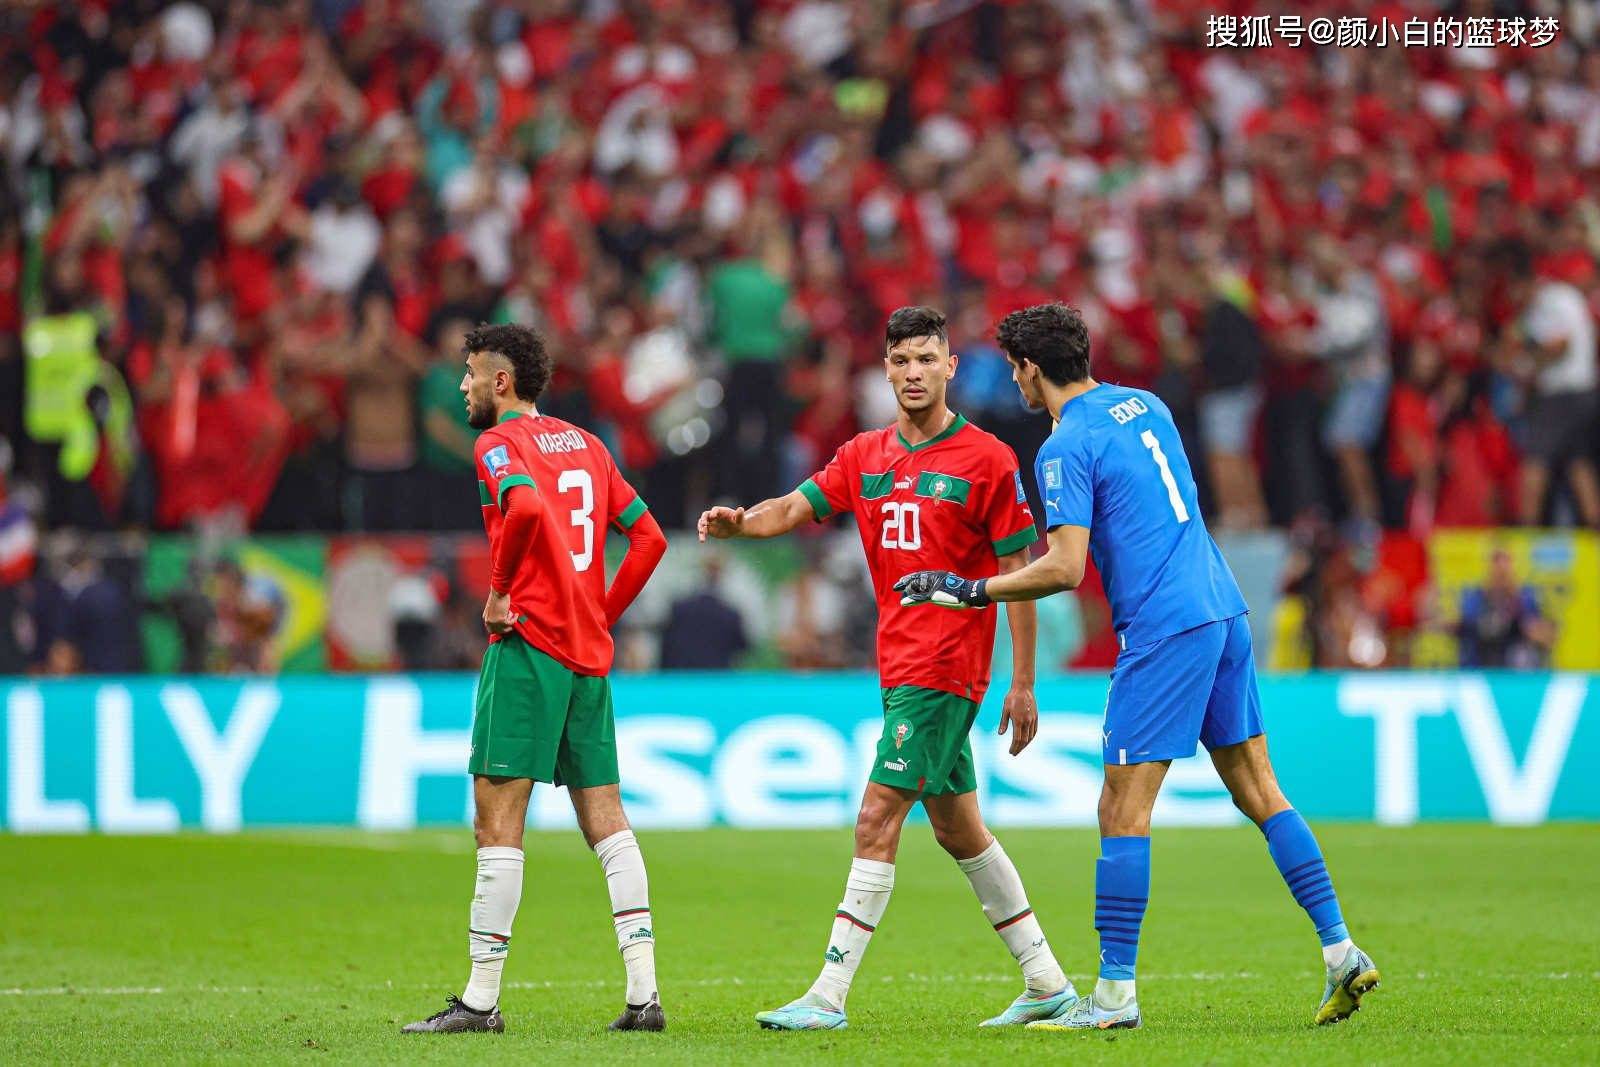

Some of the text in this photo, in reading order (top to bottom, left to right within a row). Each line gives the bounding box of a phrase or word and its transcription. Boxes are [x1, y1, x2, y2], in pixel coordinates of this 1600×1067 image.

[1108, 397, 1148, 425] BONO
[557, 469, 594, 572] 3
[1140, 429, 1190, 523] 1
[881, 501, 921, 550] 20
[6, 683, 283, 834] LLY
[1336, 672, 1591, 827] TV
